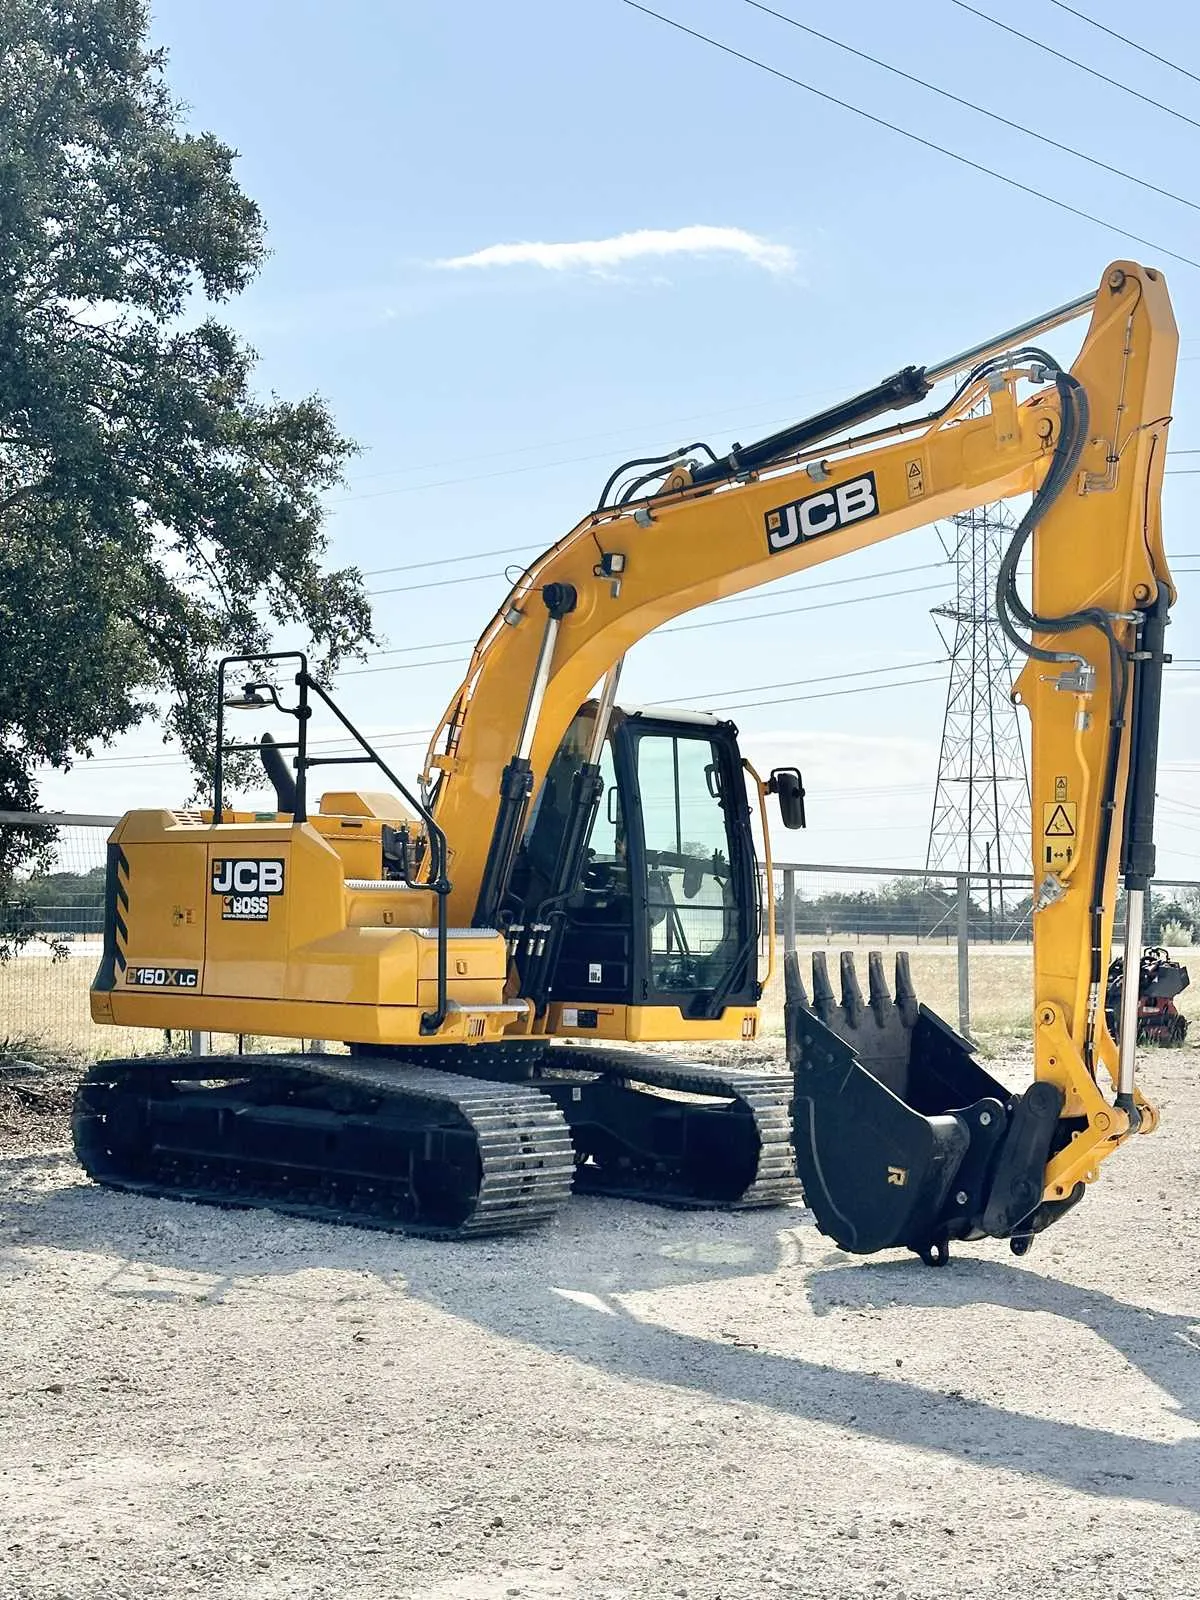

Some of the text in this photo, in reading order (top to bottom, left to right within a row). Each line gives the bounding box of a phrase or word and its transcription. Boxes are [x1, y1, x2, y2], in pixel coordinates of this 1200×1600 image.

[769, 478, 875, 549] JCB
[213, 861, 283, 892] JCB
[233, 896, 268, 914] BOSS
[179, 973, 196, 986] LC
